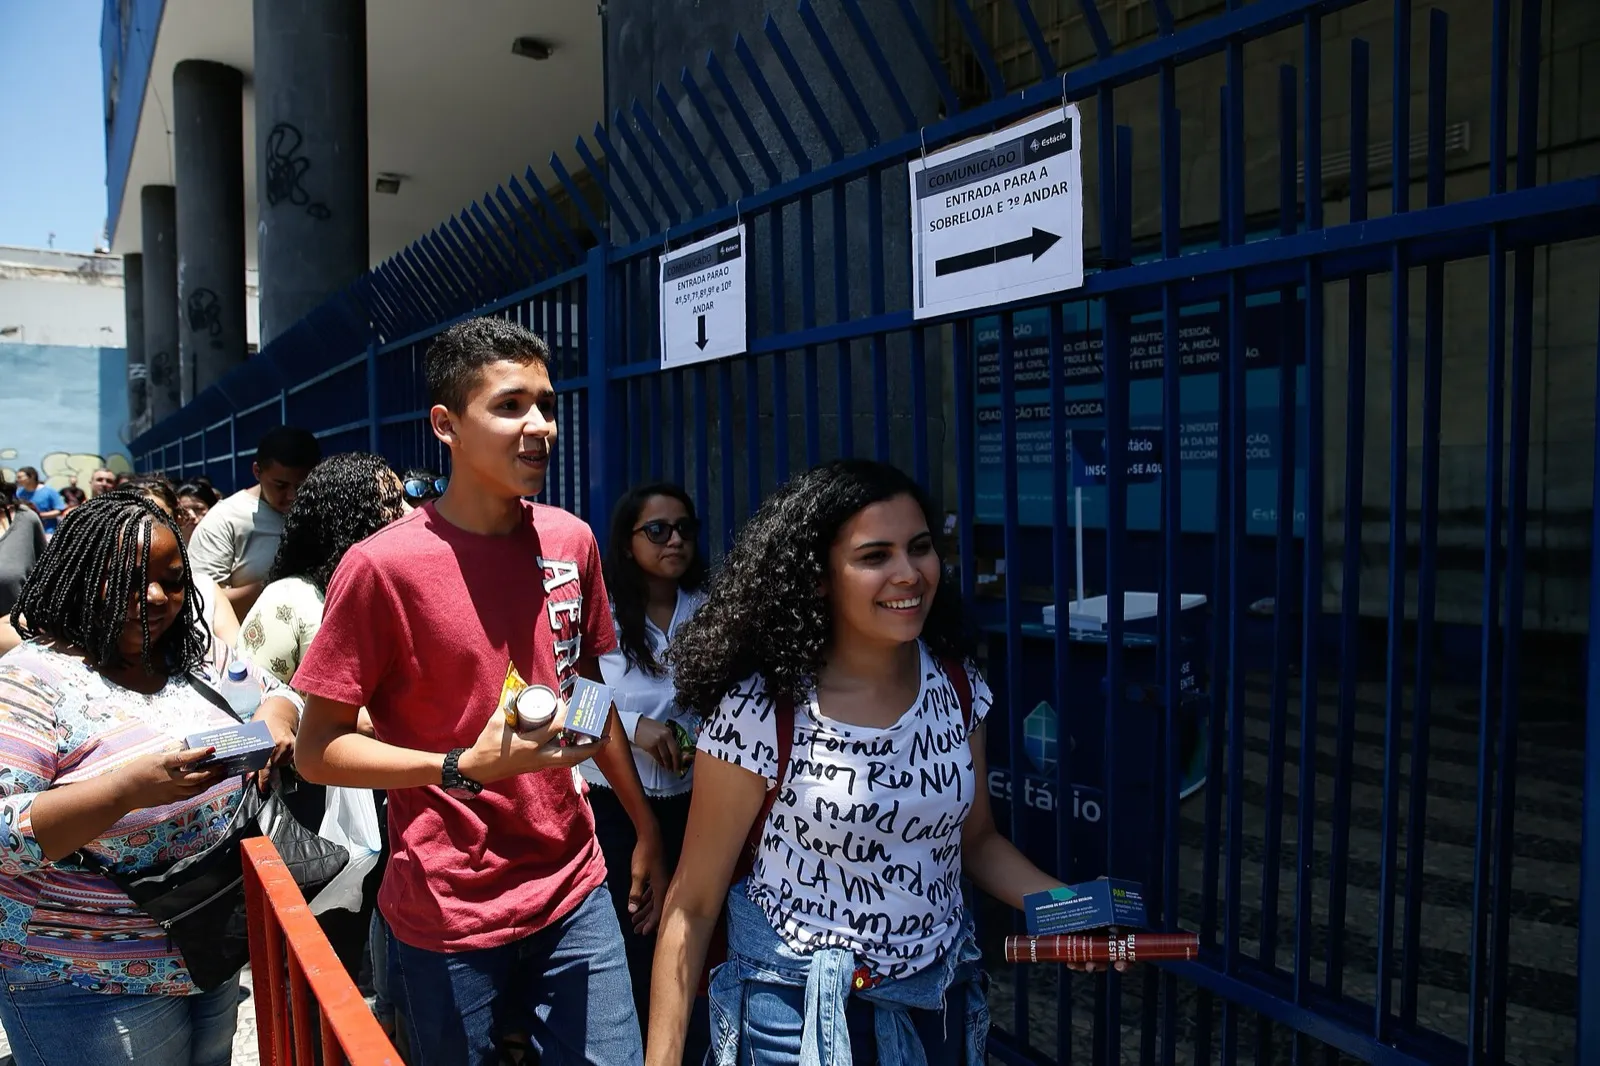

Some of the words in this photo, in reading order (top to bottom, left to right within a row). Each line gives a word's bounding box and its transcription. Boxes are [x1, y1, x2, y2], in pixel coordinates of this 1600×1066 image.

[1041, 131, 1067, 147] Estácio
[928, 151, 1016, 188] COMUNICADO
[945, 182, 1001, 209] ENTRADA
[1003, 168, 1037, 191] PARA
[1039, 166, 1049, 179] A
[929, 204, 994, 232] SOBRELOJA
[997, 200, 1004, 213] E
[1022, 181, 1068, 206] ANDAR
[667, 253, 712, 277] COMUNICADO
[677, 275, 706, 291] ENTRADA
[692, 301, 714, 315] ANDAR
[1035, 402, 1103, 417] TECLÓGICA
[867, 761, 914, 792] Rio
[920, 761, 962, 802] NY
[987, 769, 1102, 823] Estáio
[794, 815, 892, 863] Berlin
